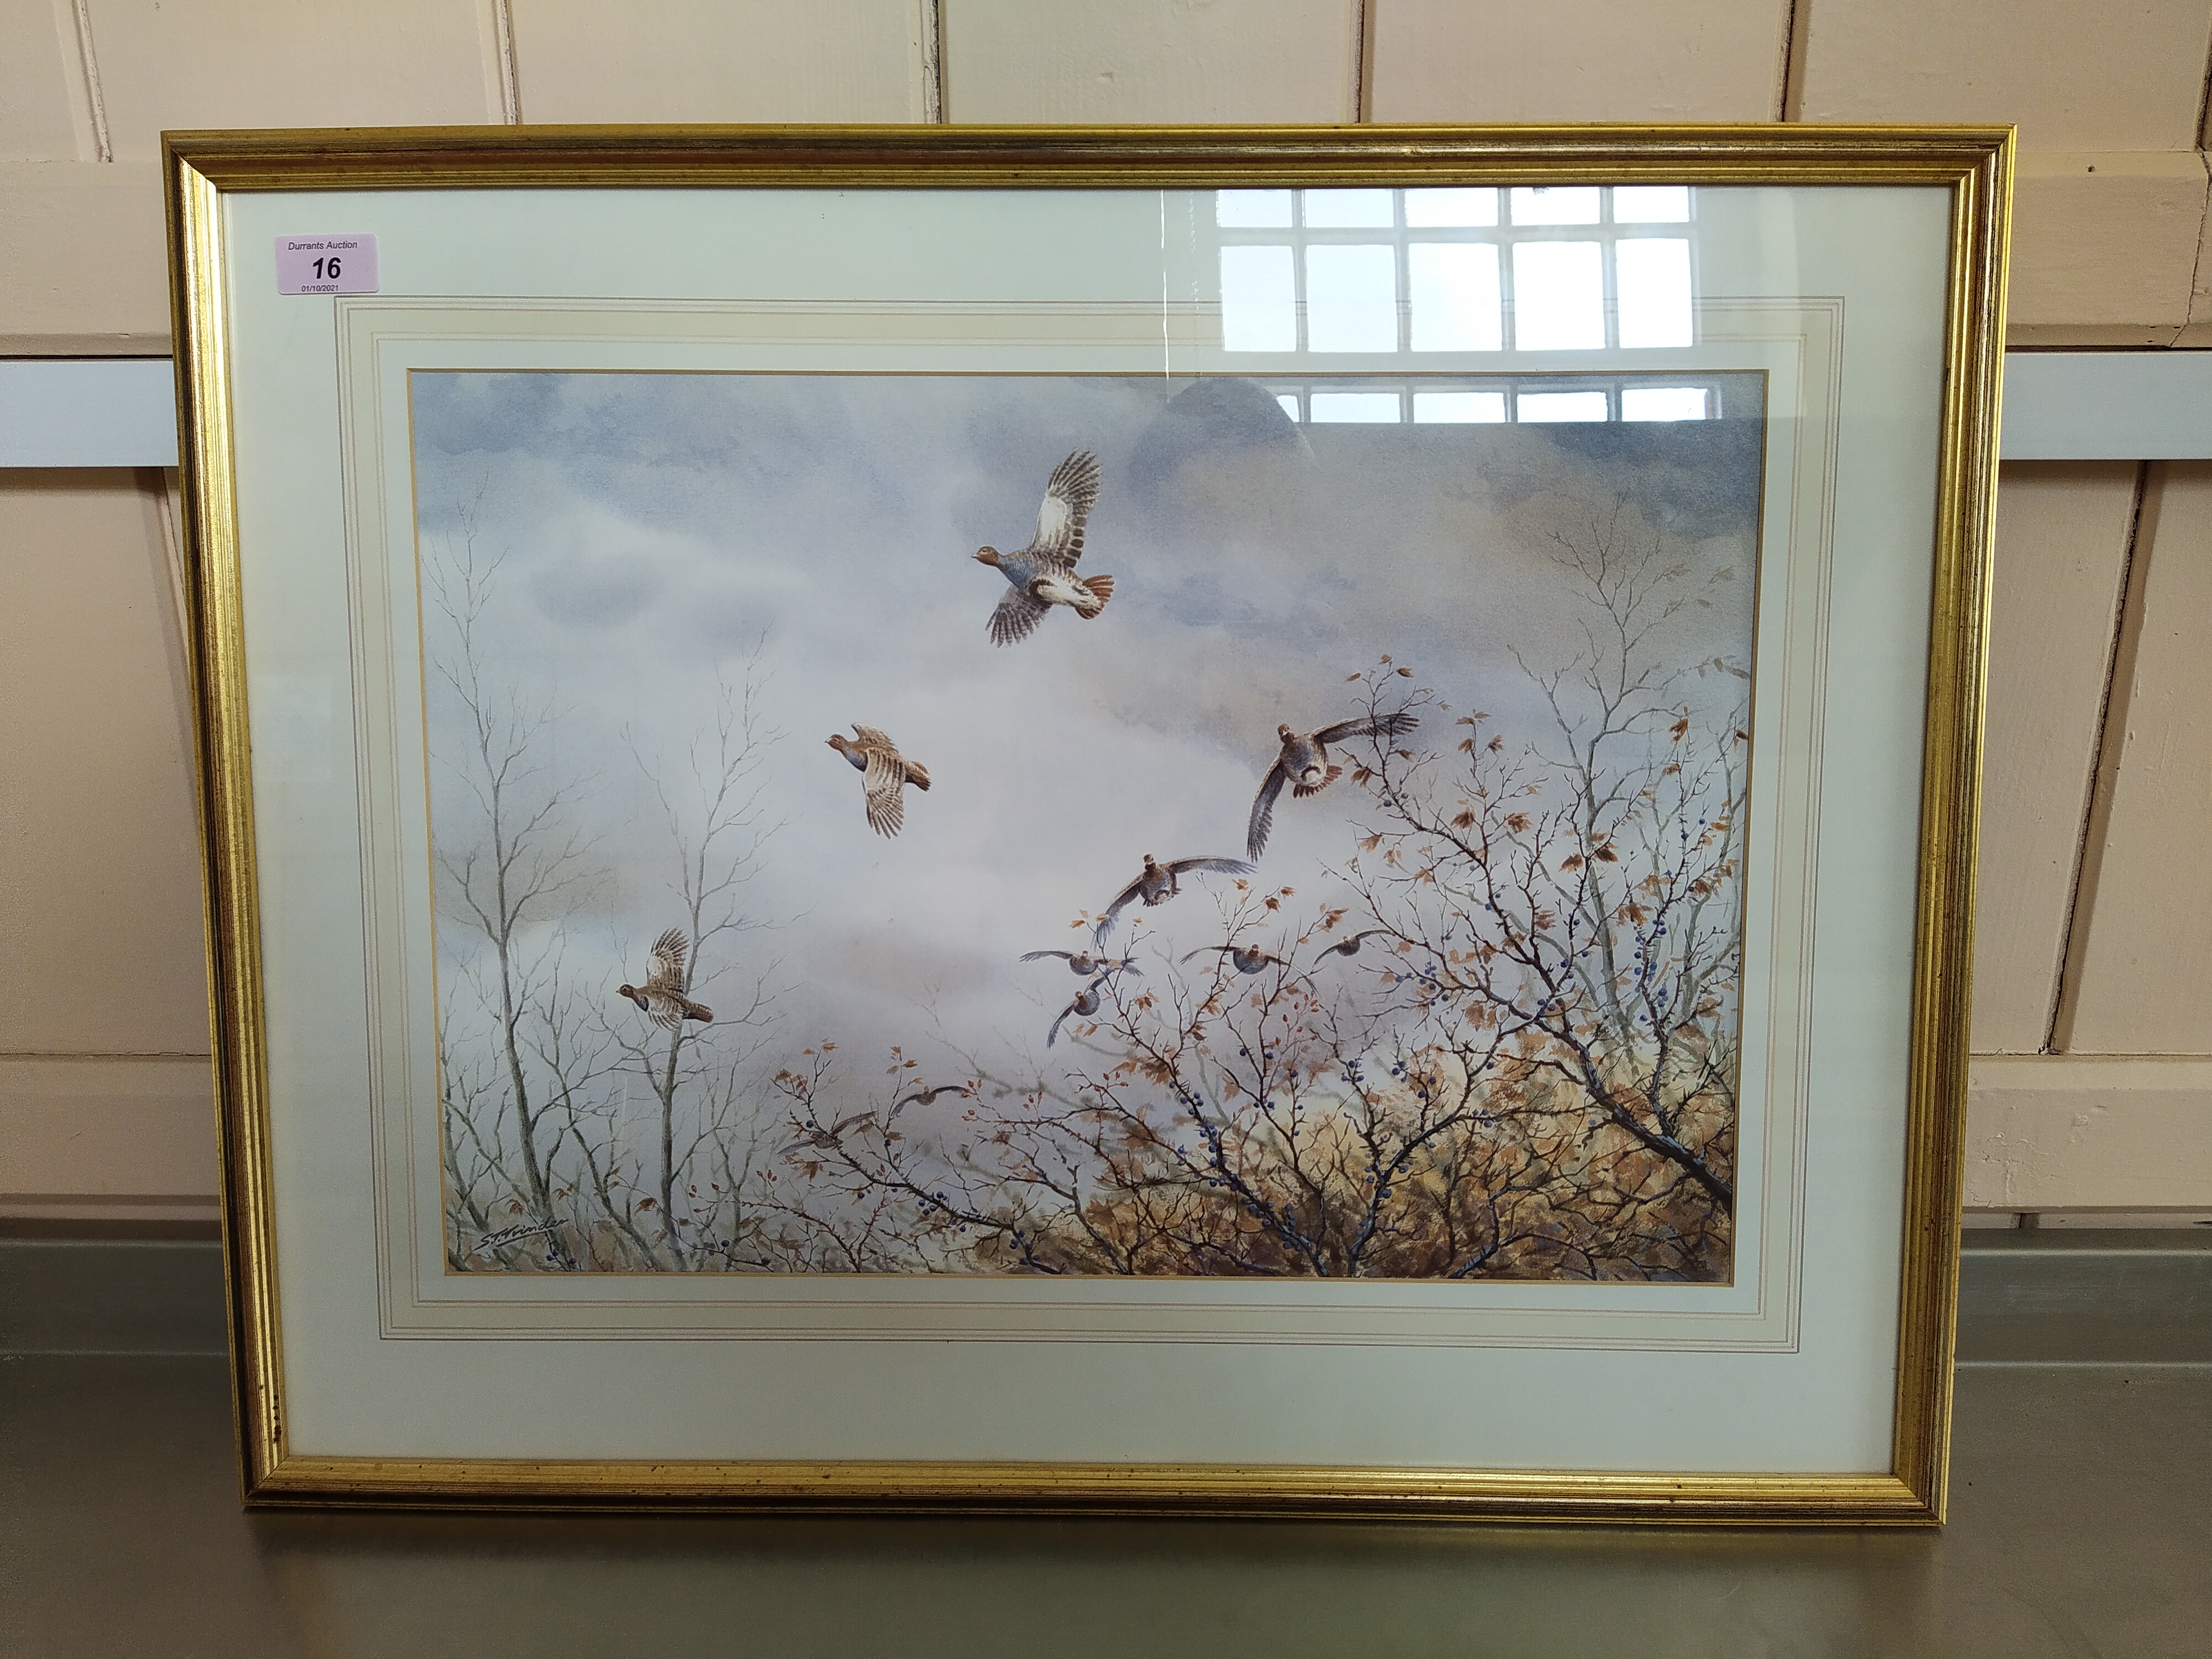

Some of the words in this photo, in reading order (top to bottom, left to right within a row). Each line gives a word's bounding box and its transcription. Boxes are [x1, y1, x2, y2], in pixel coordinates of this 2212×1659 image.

[288, 242, 324, 250] Durrants
[326, 240, 358, 249] Auction
[312, 257, 342, 279] 16
